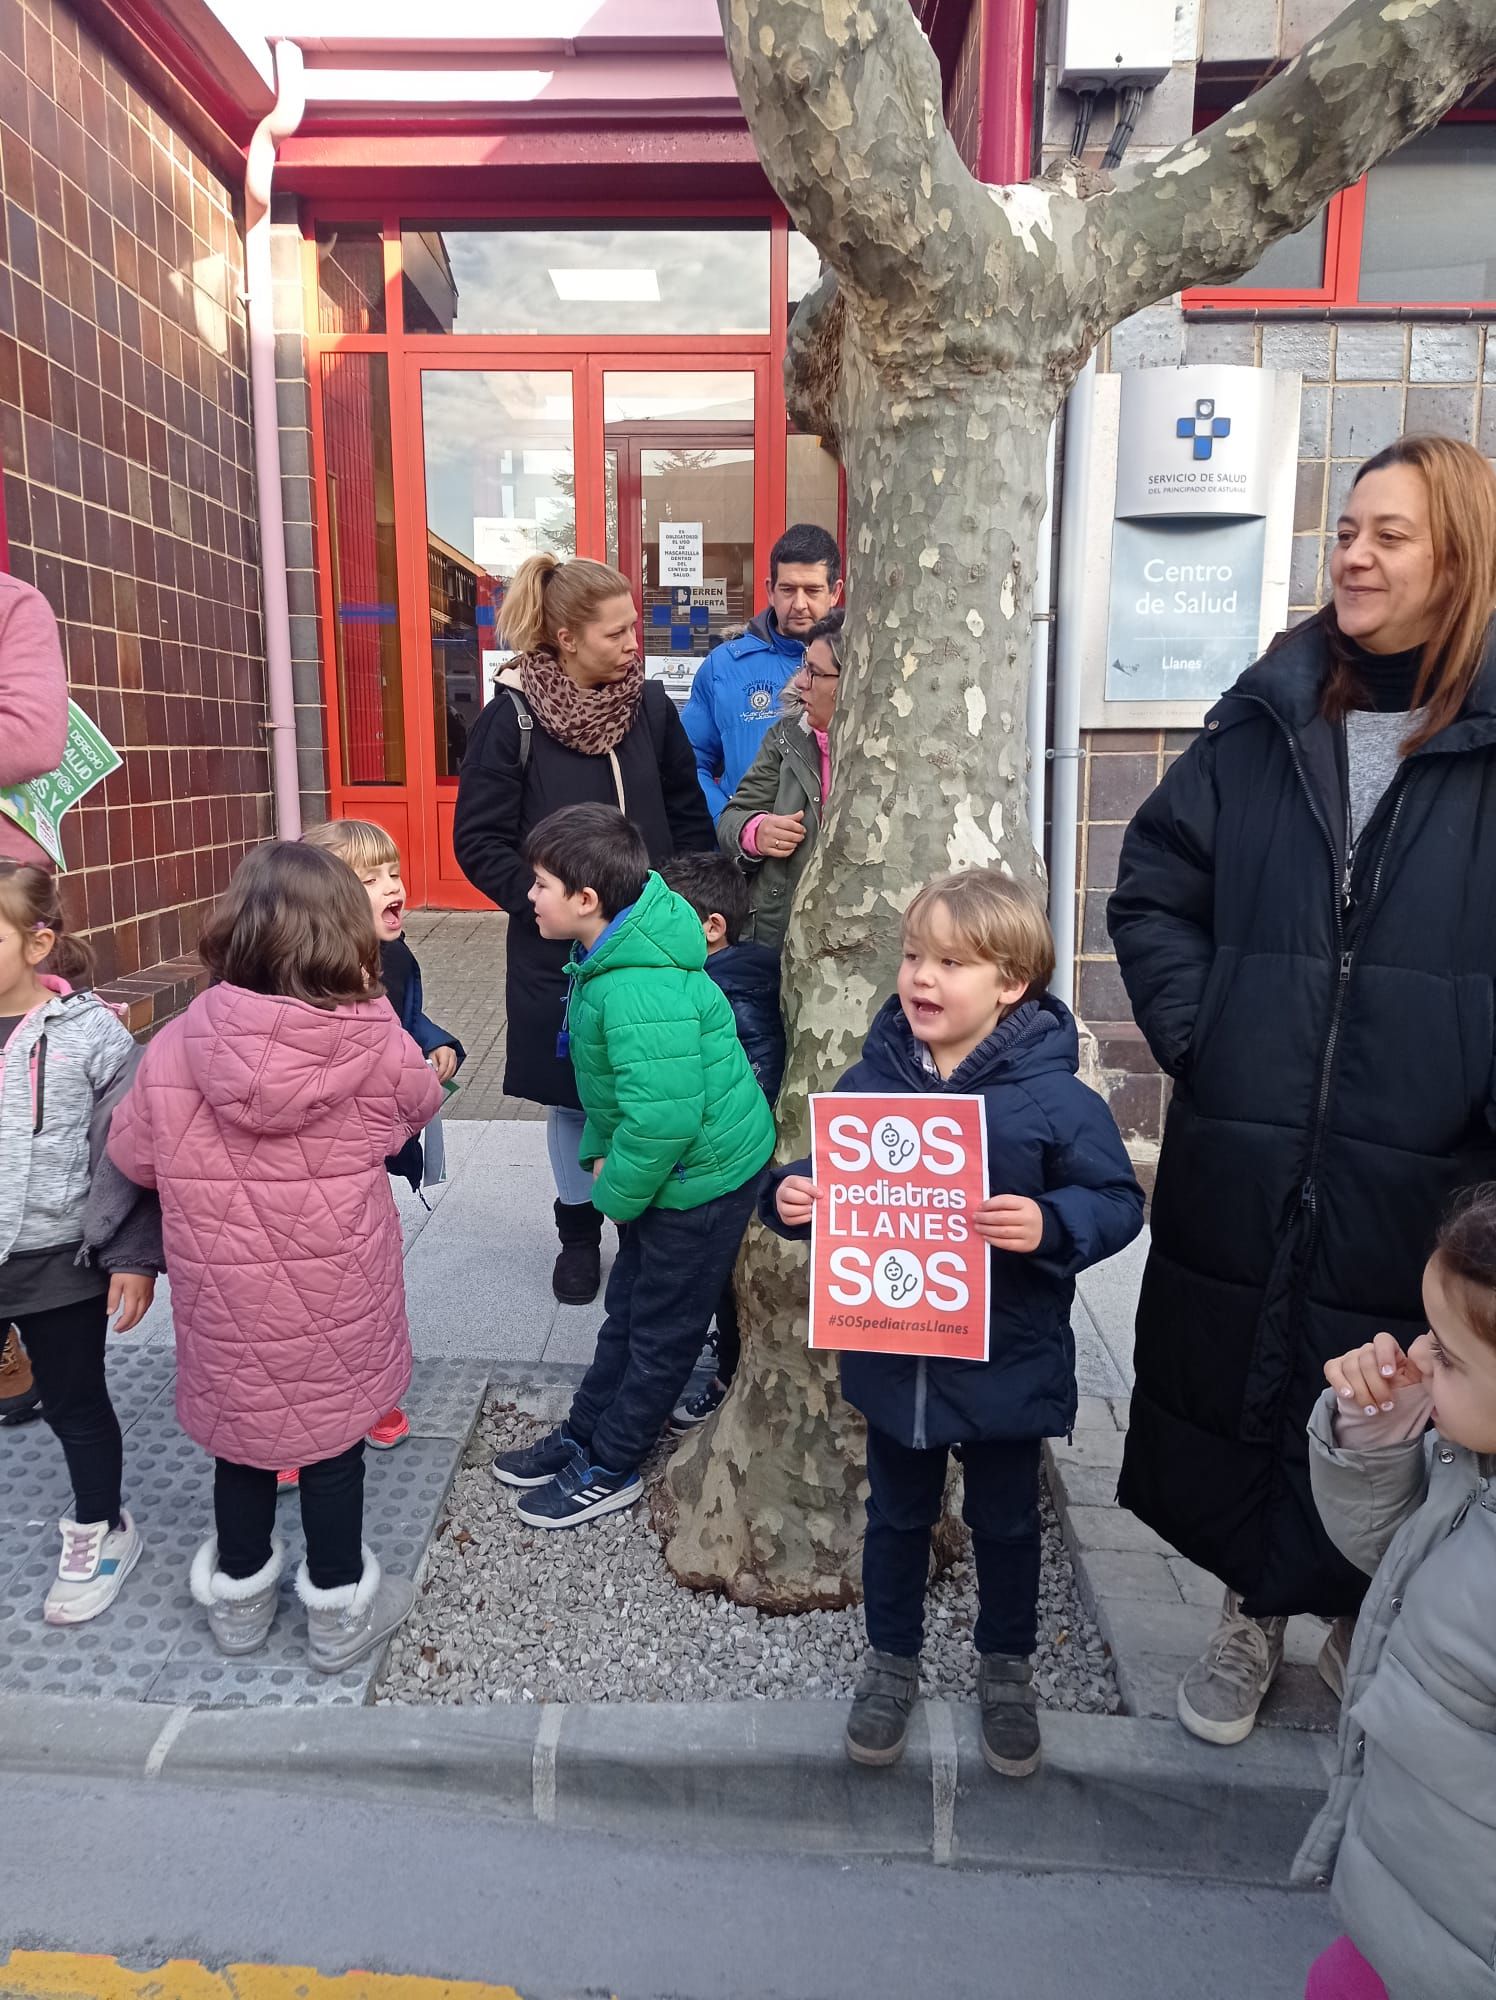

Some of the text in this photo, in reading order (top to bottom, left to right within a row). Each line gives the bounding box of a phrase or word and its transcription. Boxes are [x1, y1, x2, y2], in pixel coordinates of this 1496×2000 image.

[1148, 473, 1247, 485] SERVICIO DE SALUD
[1163, 486, 1206, 494] PRINCIPADO
[1143, 558, 1233, 582] Centro
[693, 599, 725, 607] PUERTA
[1135, 590, 1238, 615] de Salud
[1162, 656, 1202, 670] Llanes
[69, 729, 104, 770] DERECHO
[828, 1114, 967, 1175] SOS
[829, 1179, 967, 1210] pediatras
[829, 1209, 969, 1243] LLANES
[827, 1246, 970, 1312] SOS
[828, 1314, 969, 1335] #SOSpediatrasLlanes
